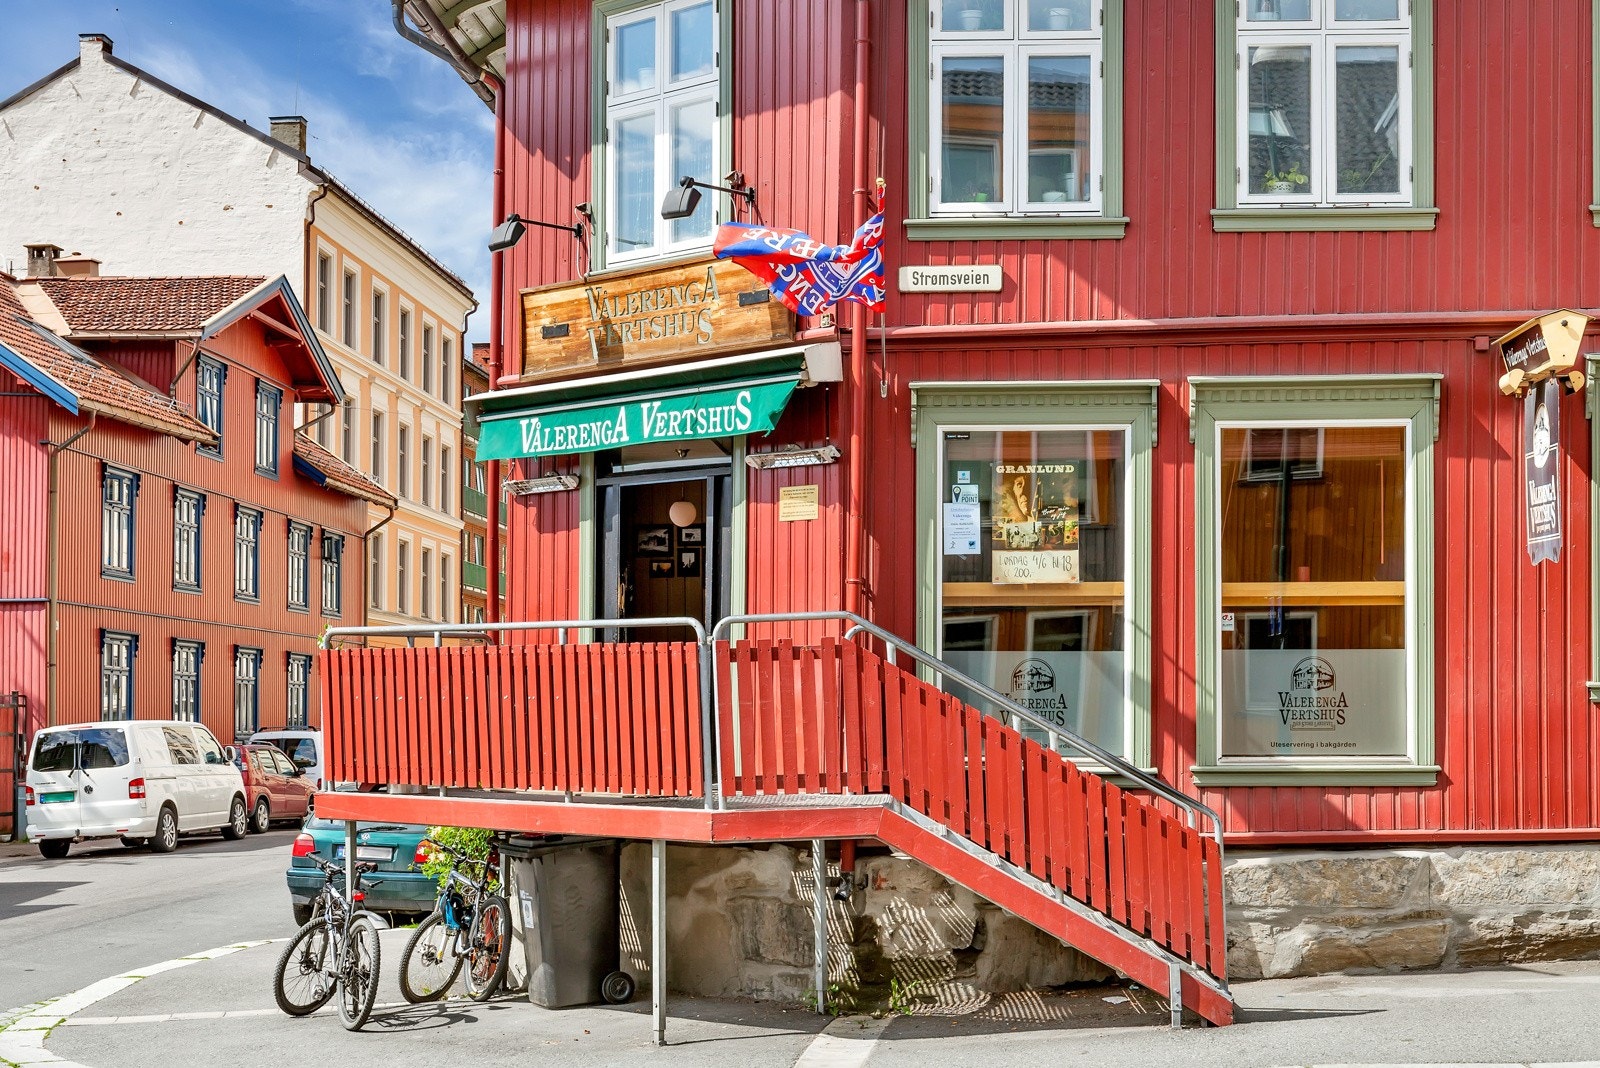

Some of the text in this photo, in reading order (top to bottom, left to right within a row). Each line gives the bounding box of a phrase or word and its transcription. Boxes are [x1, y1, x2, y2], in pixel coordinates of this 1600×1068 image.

[912, 270, 989, 286] Strømsveien
[585, 266, 720, 322] VÅLERENGA
[587, 308, 713, 360] VERTSHUS
[519, 391, 751, 453] VÅLERENGA VERTSHUS
[996, 465, 1075, 474] GRANLUND
[1062, 555, 1073, 572] 18
[1278, 692, 1349, 708] VÅLERENGA
[1280, 709, 1346, 725] VERTSHUS
[1270, 741, 1315, 749] Uteservering
[1320, 741, 1357, 749] bakgården
